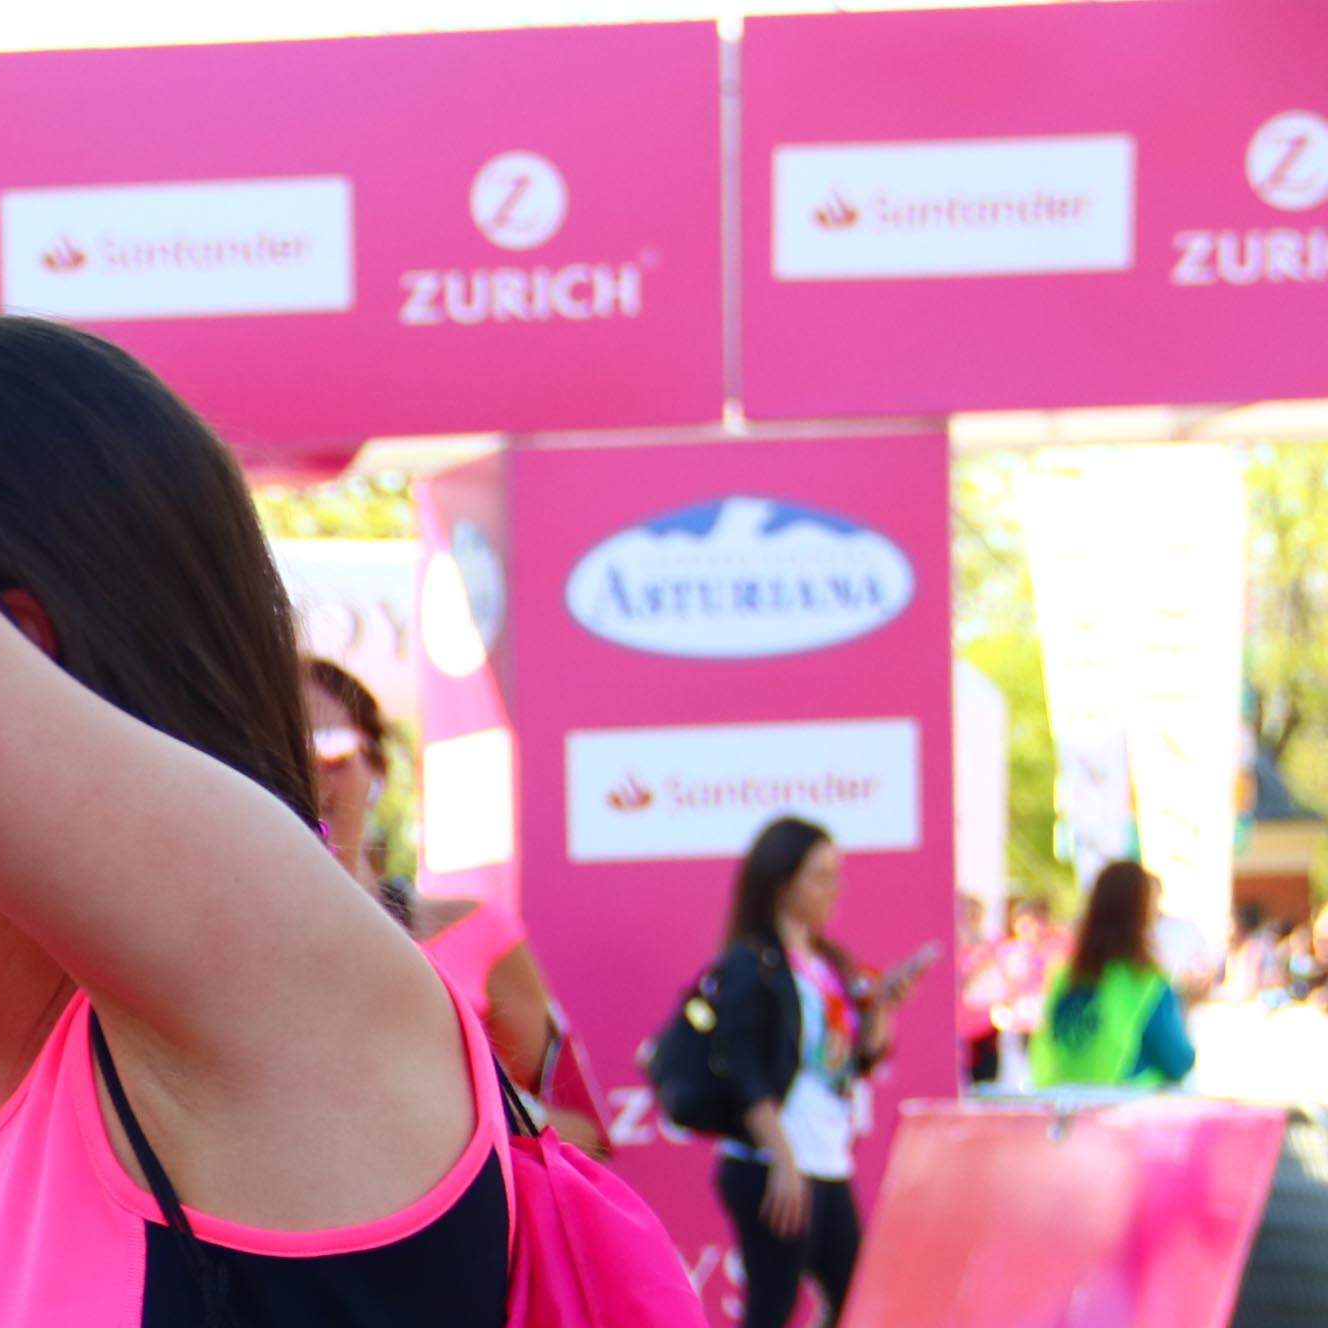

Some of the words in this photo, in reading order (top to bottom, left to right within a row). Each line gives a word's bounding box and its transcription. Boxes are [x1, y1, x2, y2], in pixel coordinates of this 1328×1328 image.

[869, 187, 1092, 236] Santander
[96, 226, 314, 275] Santander
[398, 262, 642, 327] ZURICH
[597, 565, 884, 621] ASTURIANA
[663, 771, 878, 815] Santander
